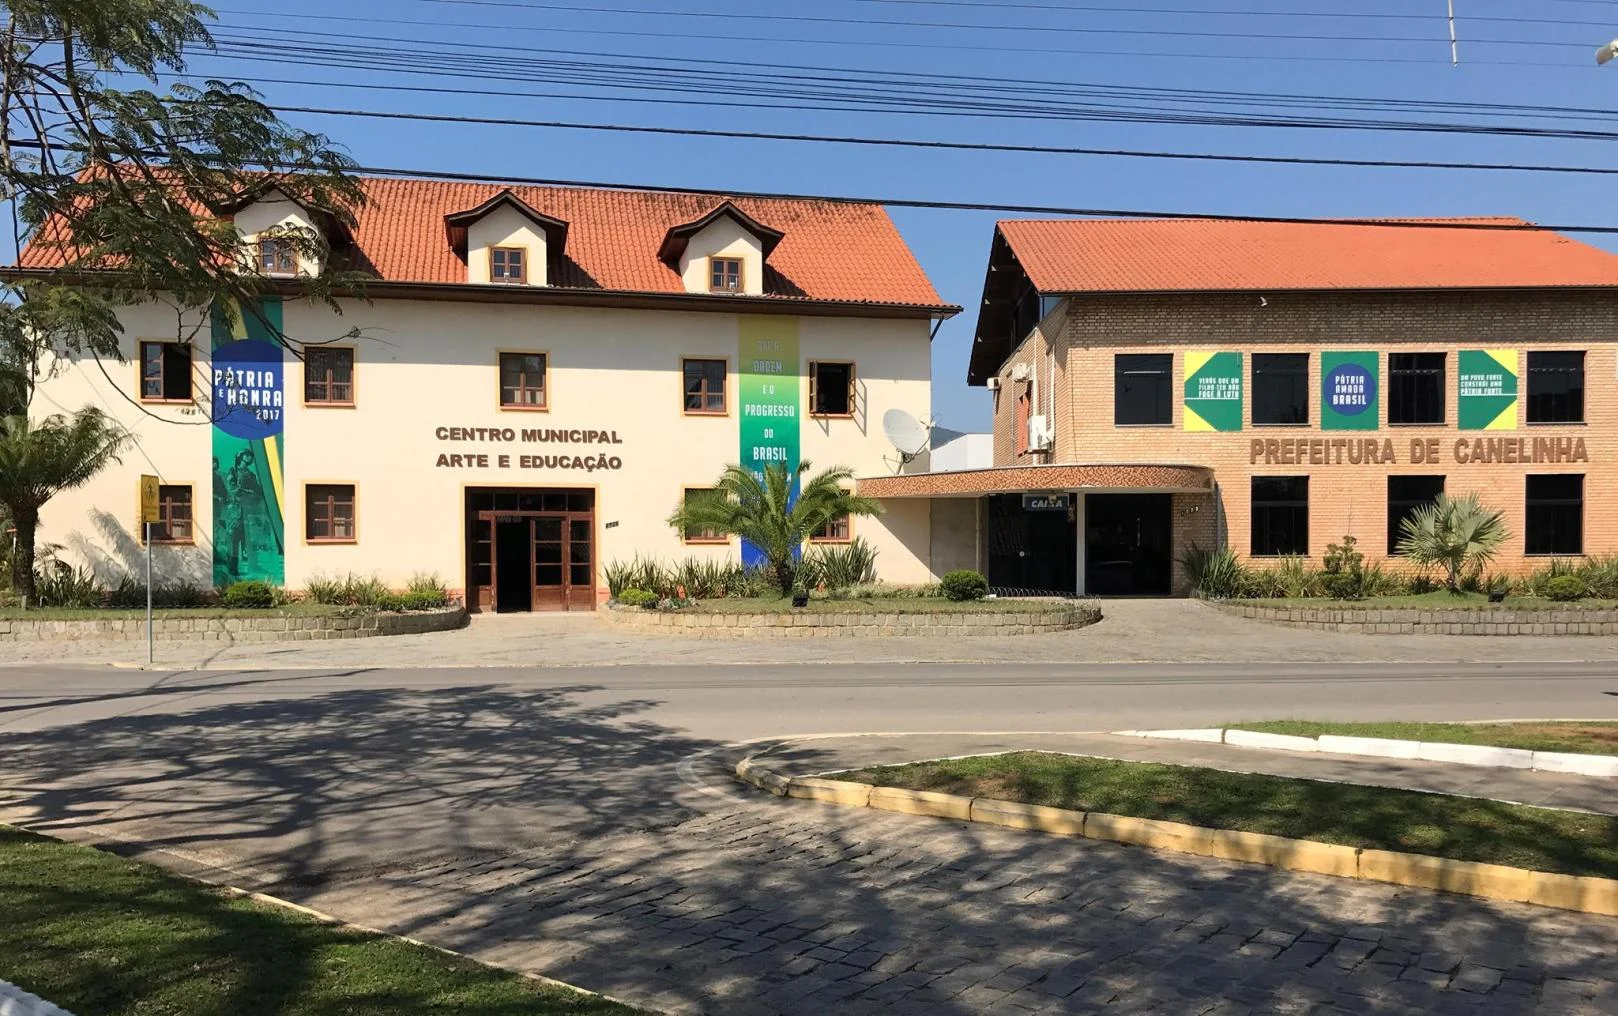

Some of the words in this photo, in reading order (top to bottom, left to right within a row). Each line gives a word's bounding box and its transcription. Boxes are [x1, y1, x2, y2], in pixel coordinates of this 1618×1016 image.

[753, 360, 783, 373] ORDEM
[214, 366, 274, 388] PÁTRIA
[1335, 374, 1365, 384] PÁTRIA
[769, 384, 774, 394] O
[1335, 385, 1364, 394] AMADA
[219, 389, 224, 398] E
[227, 388, 282, 407] HONRA
[1332, 394, 1367, 405] BRASIL
[256, 408, 280, 420] 2017
[745, 404, 795, 417] PROGRESSO
[435, 426, 516, 442] CENTRO
[521, 429, 622, 444] MUNICIPAL
[764, 428, 774, 438] DO
[753, 446, 787, 460] BRASIL
[1250, 438, 1396, 465] PREFEITURA
[1410, 438, 1440, 464] DE
[1453, 437, 1588, 464] CANELINHA
[436, 454, 489, 468] ARTE
[498, 455, 511, 468] E
[520, 453, 622, 472] EDUCAÇÃO
